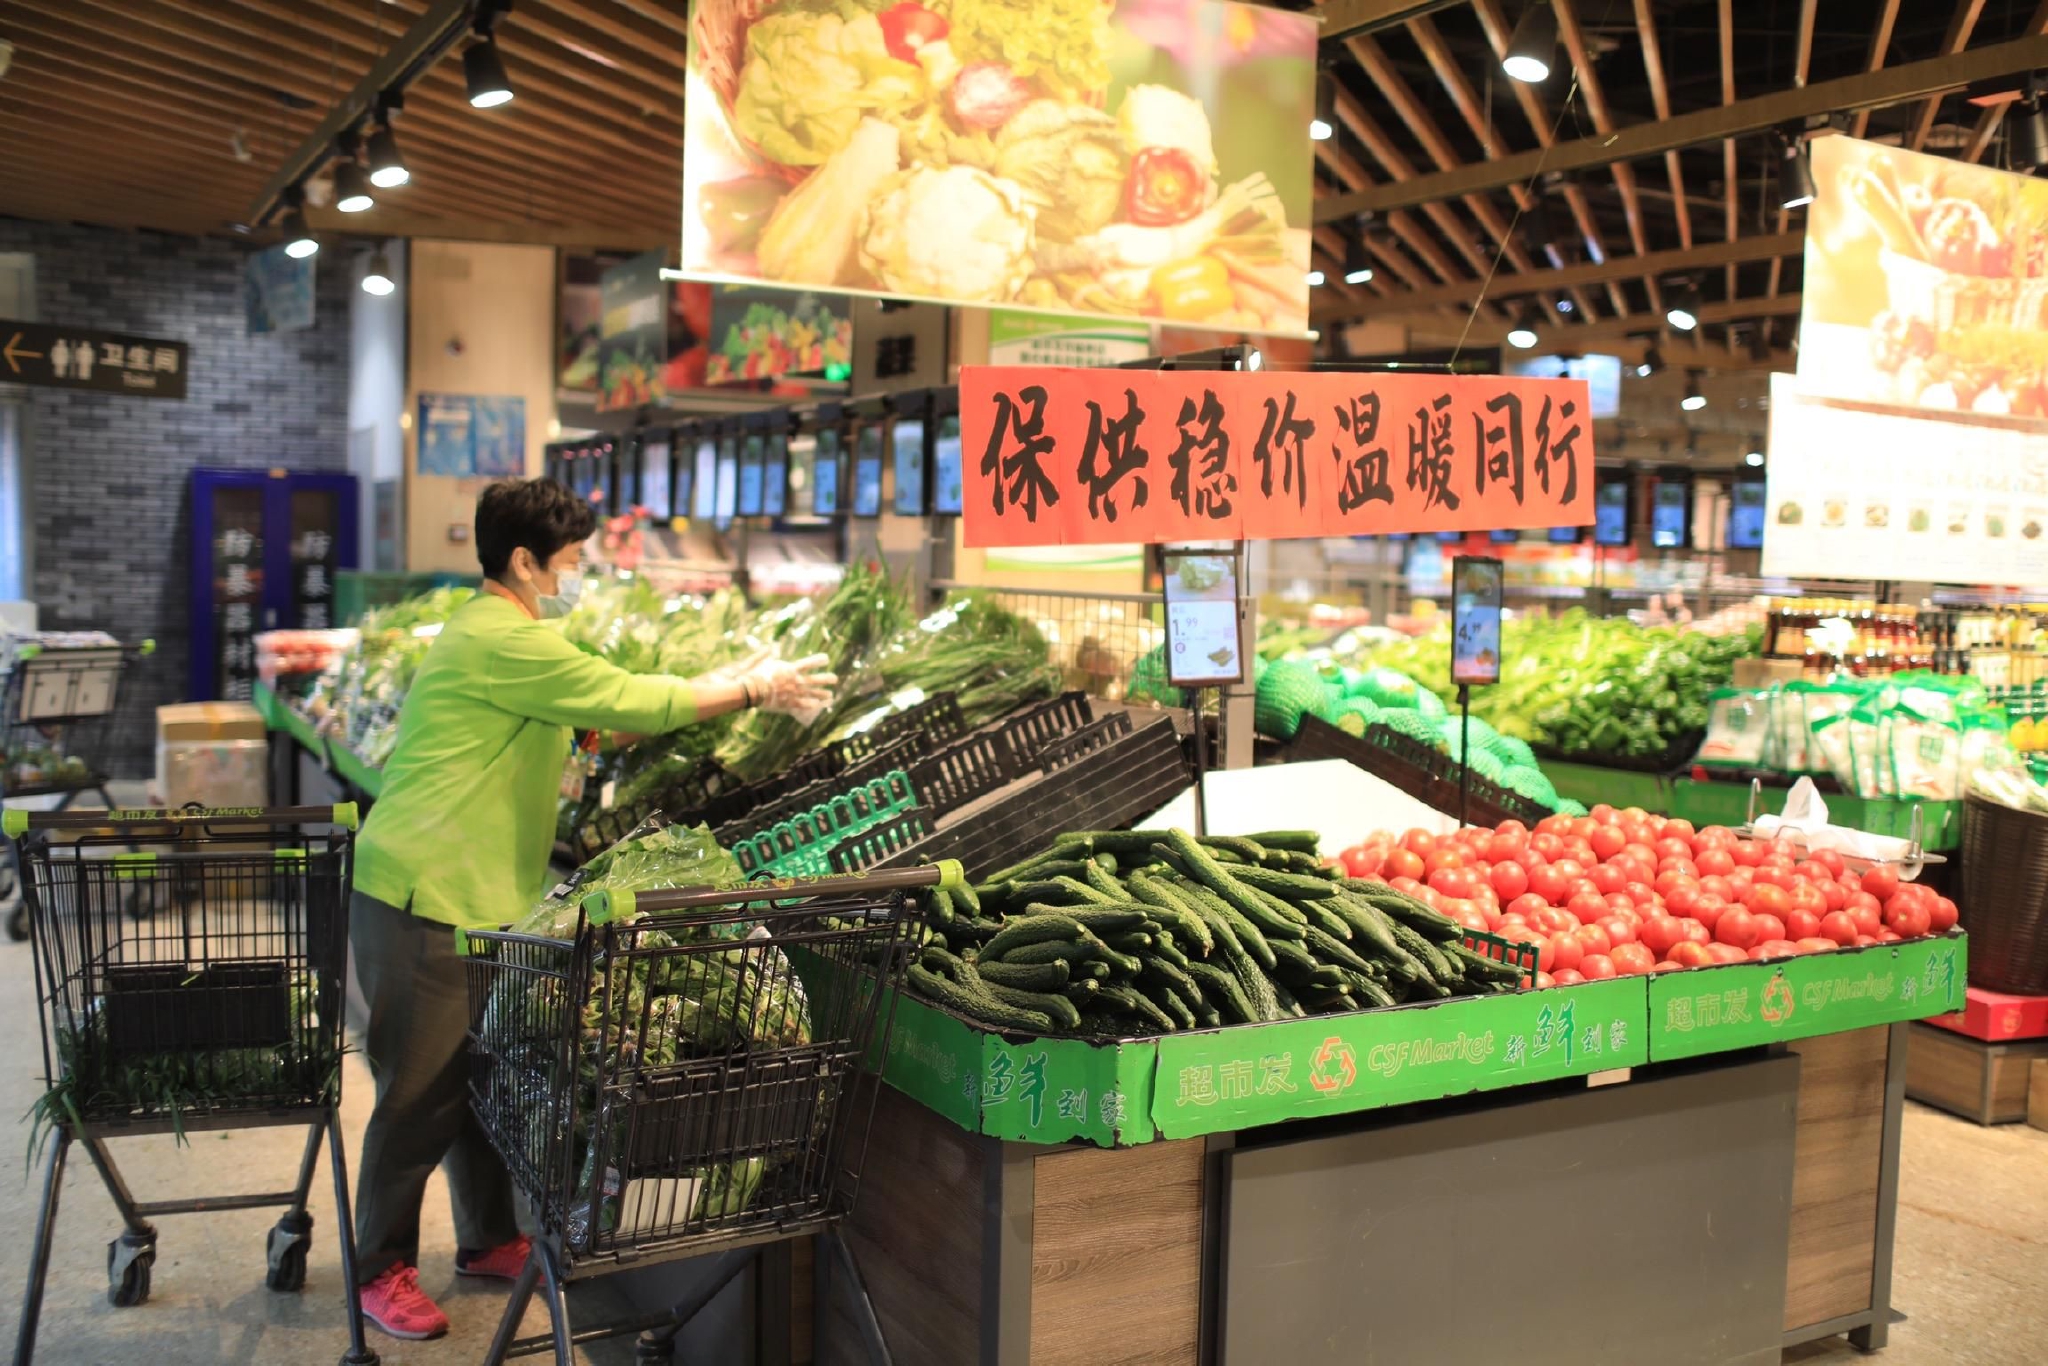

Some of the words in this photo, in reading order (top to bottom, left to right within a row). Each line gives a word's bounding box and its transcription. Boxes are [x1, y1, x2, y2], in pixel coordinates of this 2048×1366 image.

[100, 341, 179, 374] 卫生间
[980, 384, 1579, 523] 保供稳价温暖同行
[215, 806, 264, 818] Market
[1664, 987, 1753, 1032] 超市发
[1802, 978, 1833, 1011] CSF
[1833, 971, 1896, 1002] Market
[1368, 1040, 1410, 1079] CSF
[1408, 1030, 1495, 1068] Market
[1502, 998, 1629, 1068] 新鲜到家
[1175, 1051, 1298, 1107] 超市发
